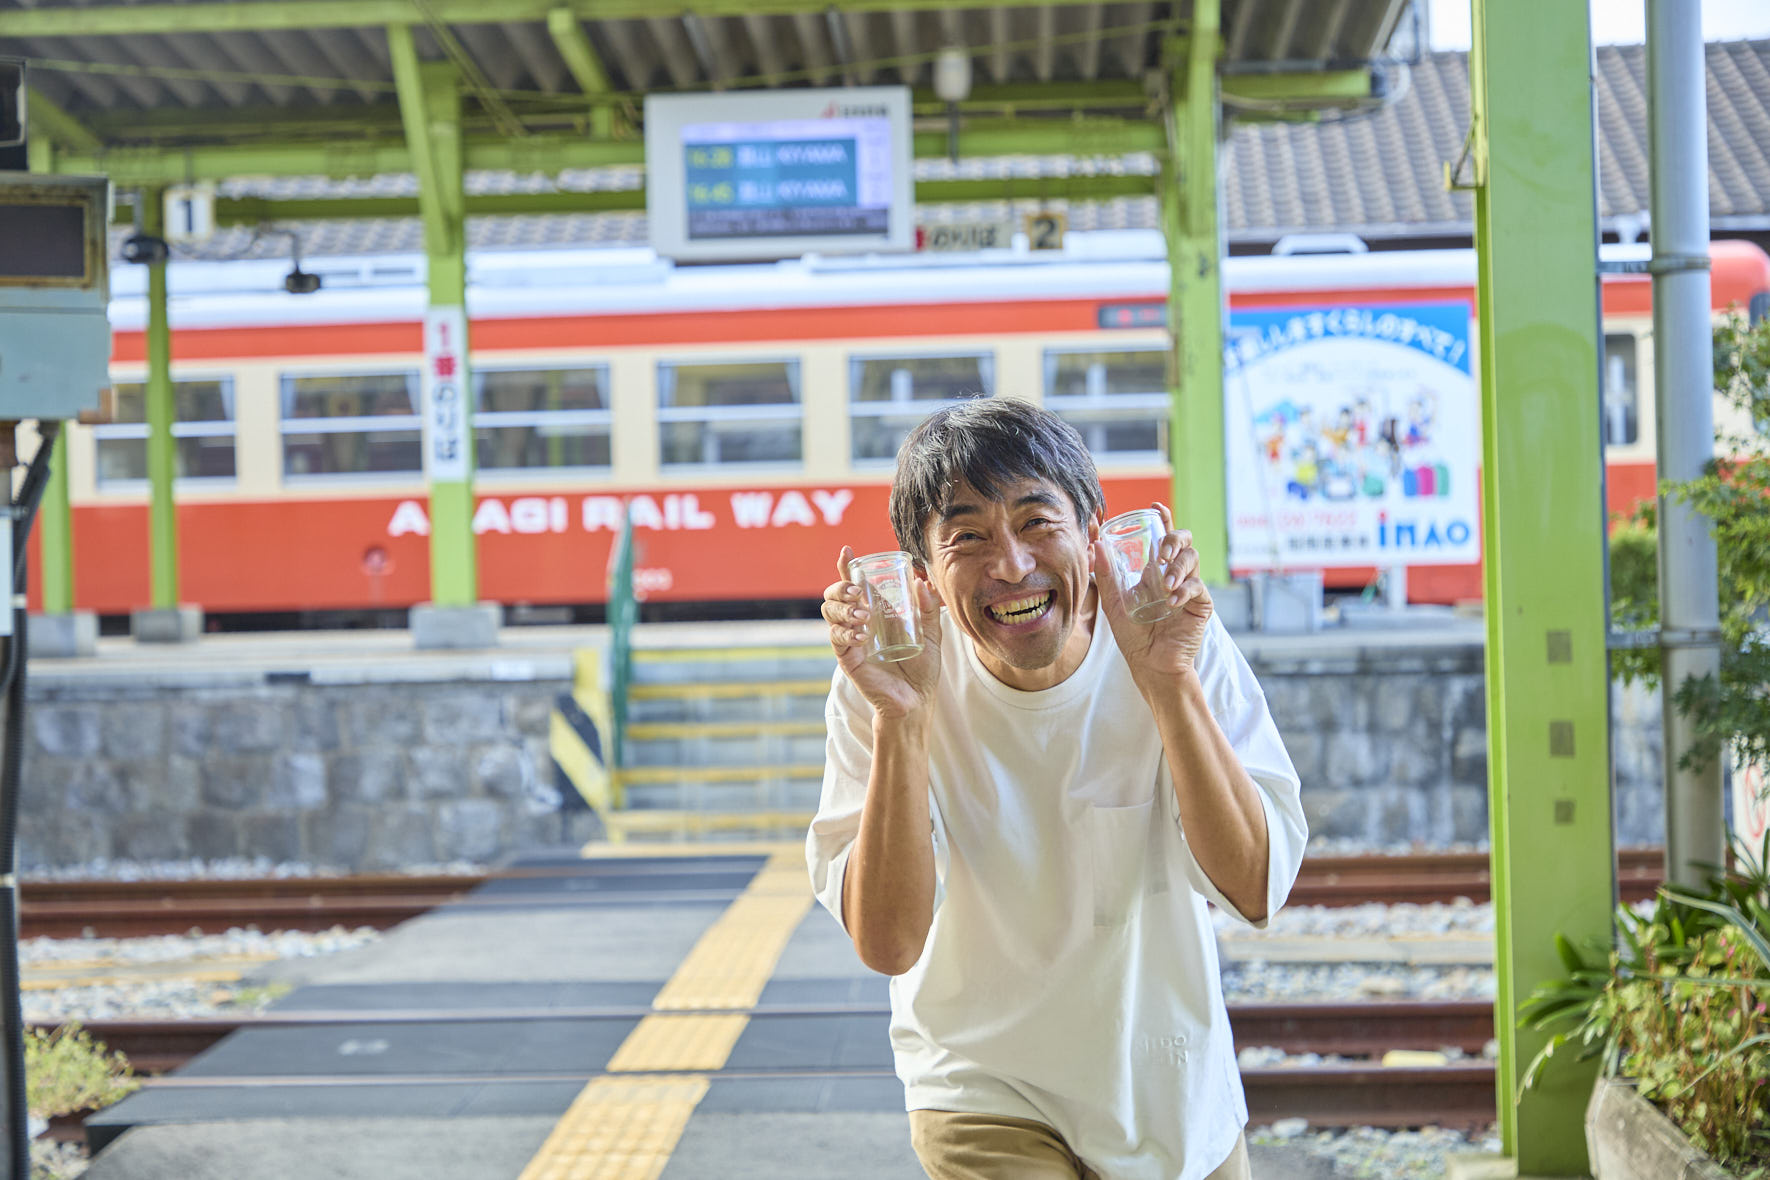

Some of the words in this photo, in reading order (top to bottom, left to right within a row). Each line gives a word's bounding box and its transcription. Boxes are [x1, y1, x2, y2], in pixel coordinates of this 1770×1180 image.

[175, 199, 193, 234] 1
[1034, 217, 1057, 248] 2
[387, 497, 569, 537] AAGI
[581, 493, 717, 532] RAIL
[729, 488, 854, 528] WAY
